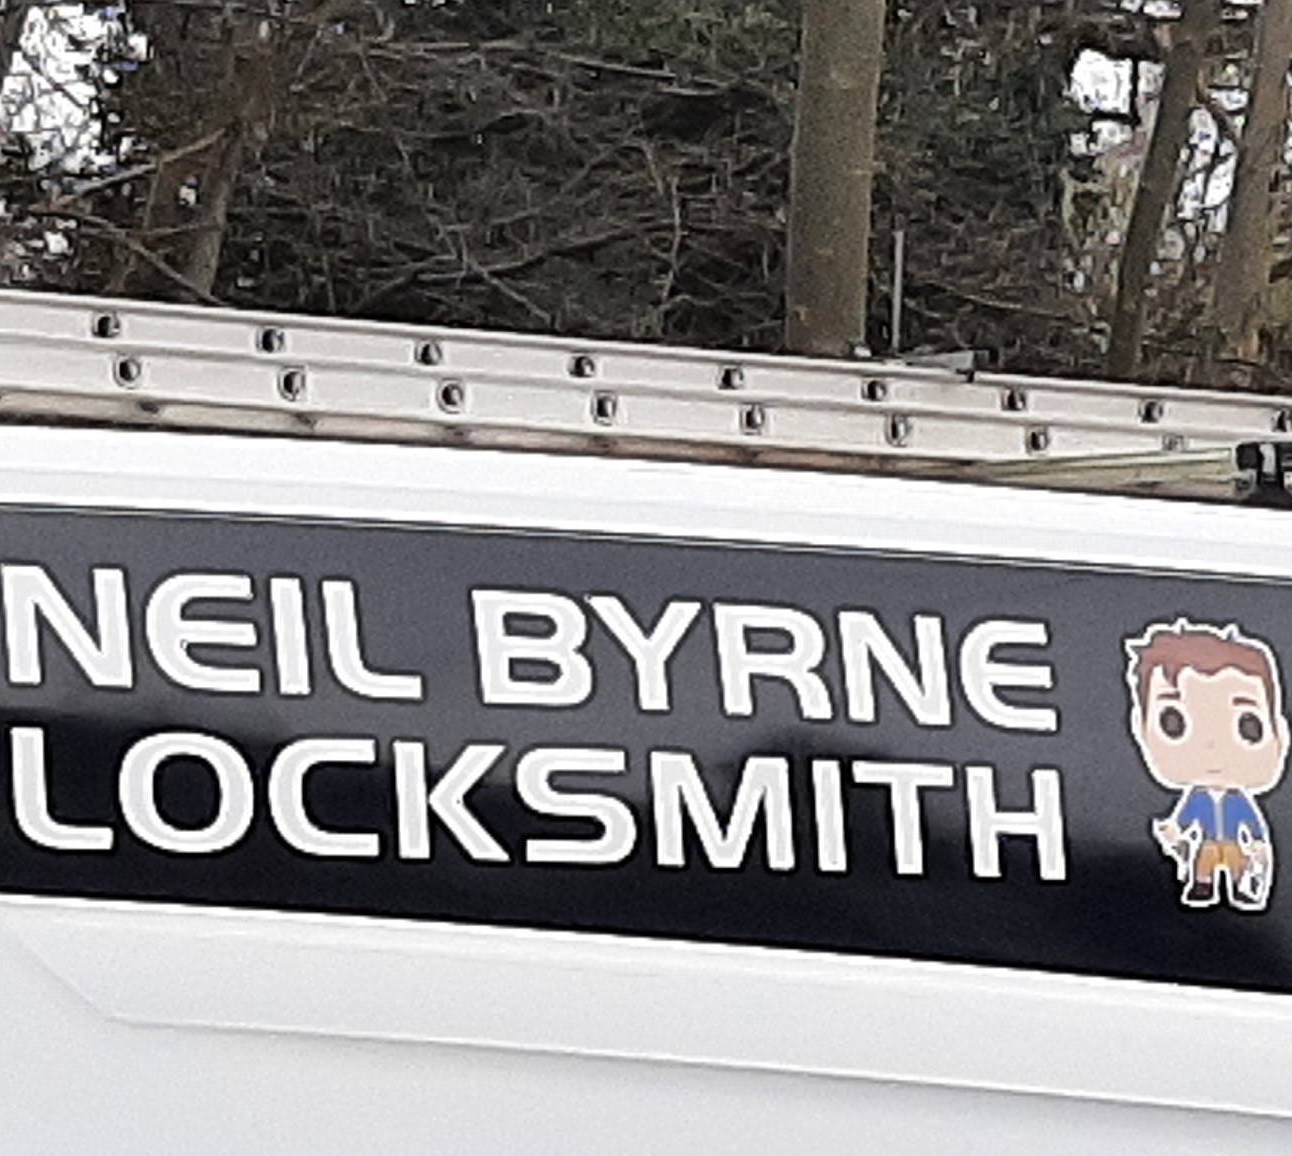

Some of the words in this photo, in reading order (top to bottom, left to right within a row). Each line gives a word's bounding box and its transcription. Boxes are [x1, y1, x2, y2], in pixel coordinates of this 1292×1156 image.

[0, 563, 424, 700] NEIL
[471, 588, 1060, 733] BYRNE
[10, 726, 1068, 882] LOCKSMITH
